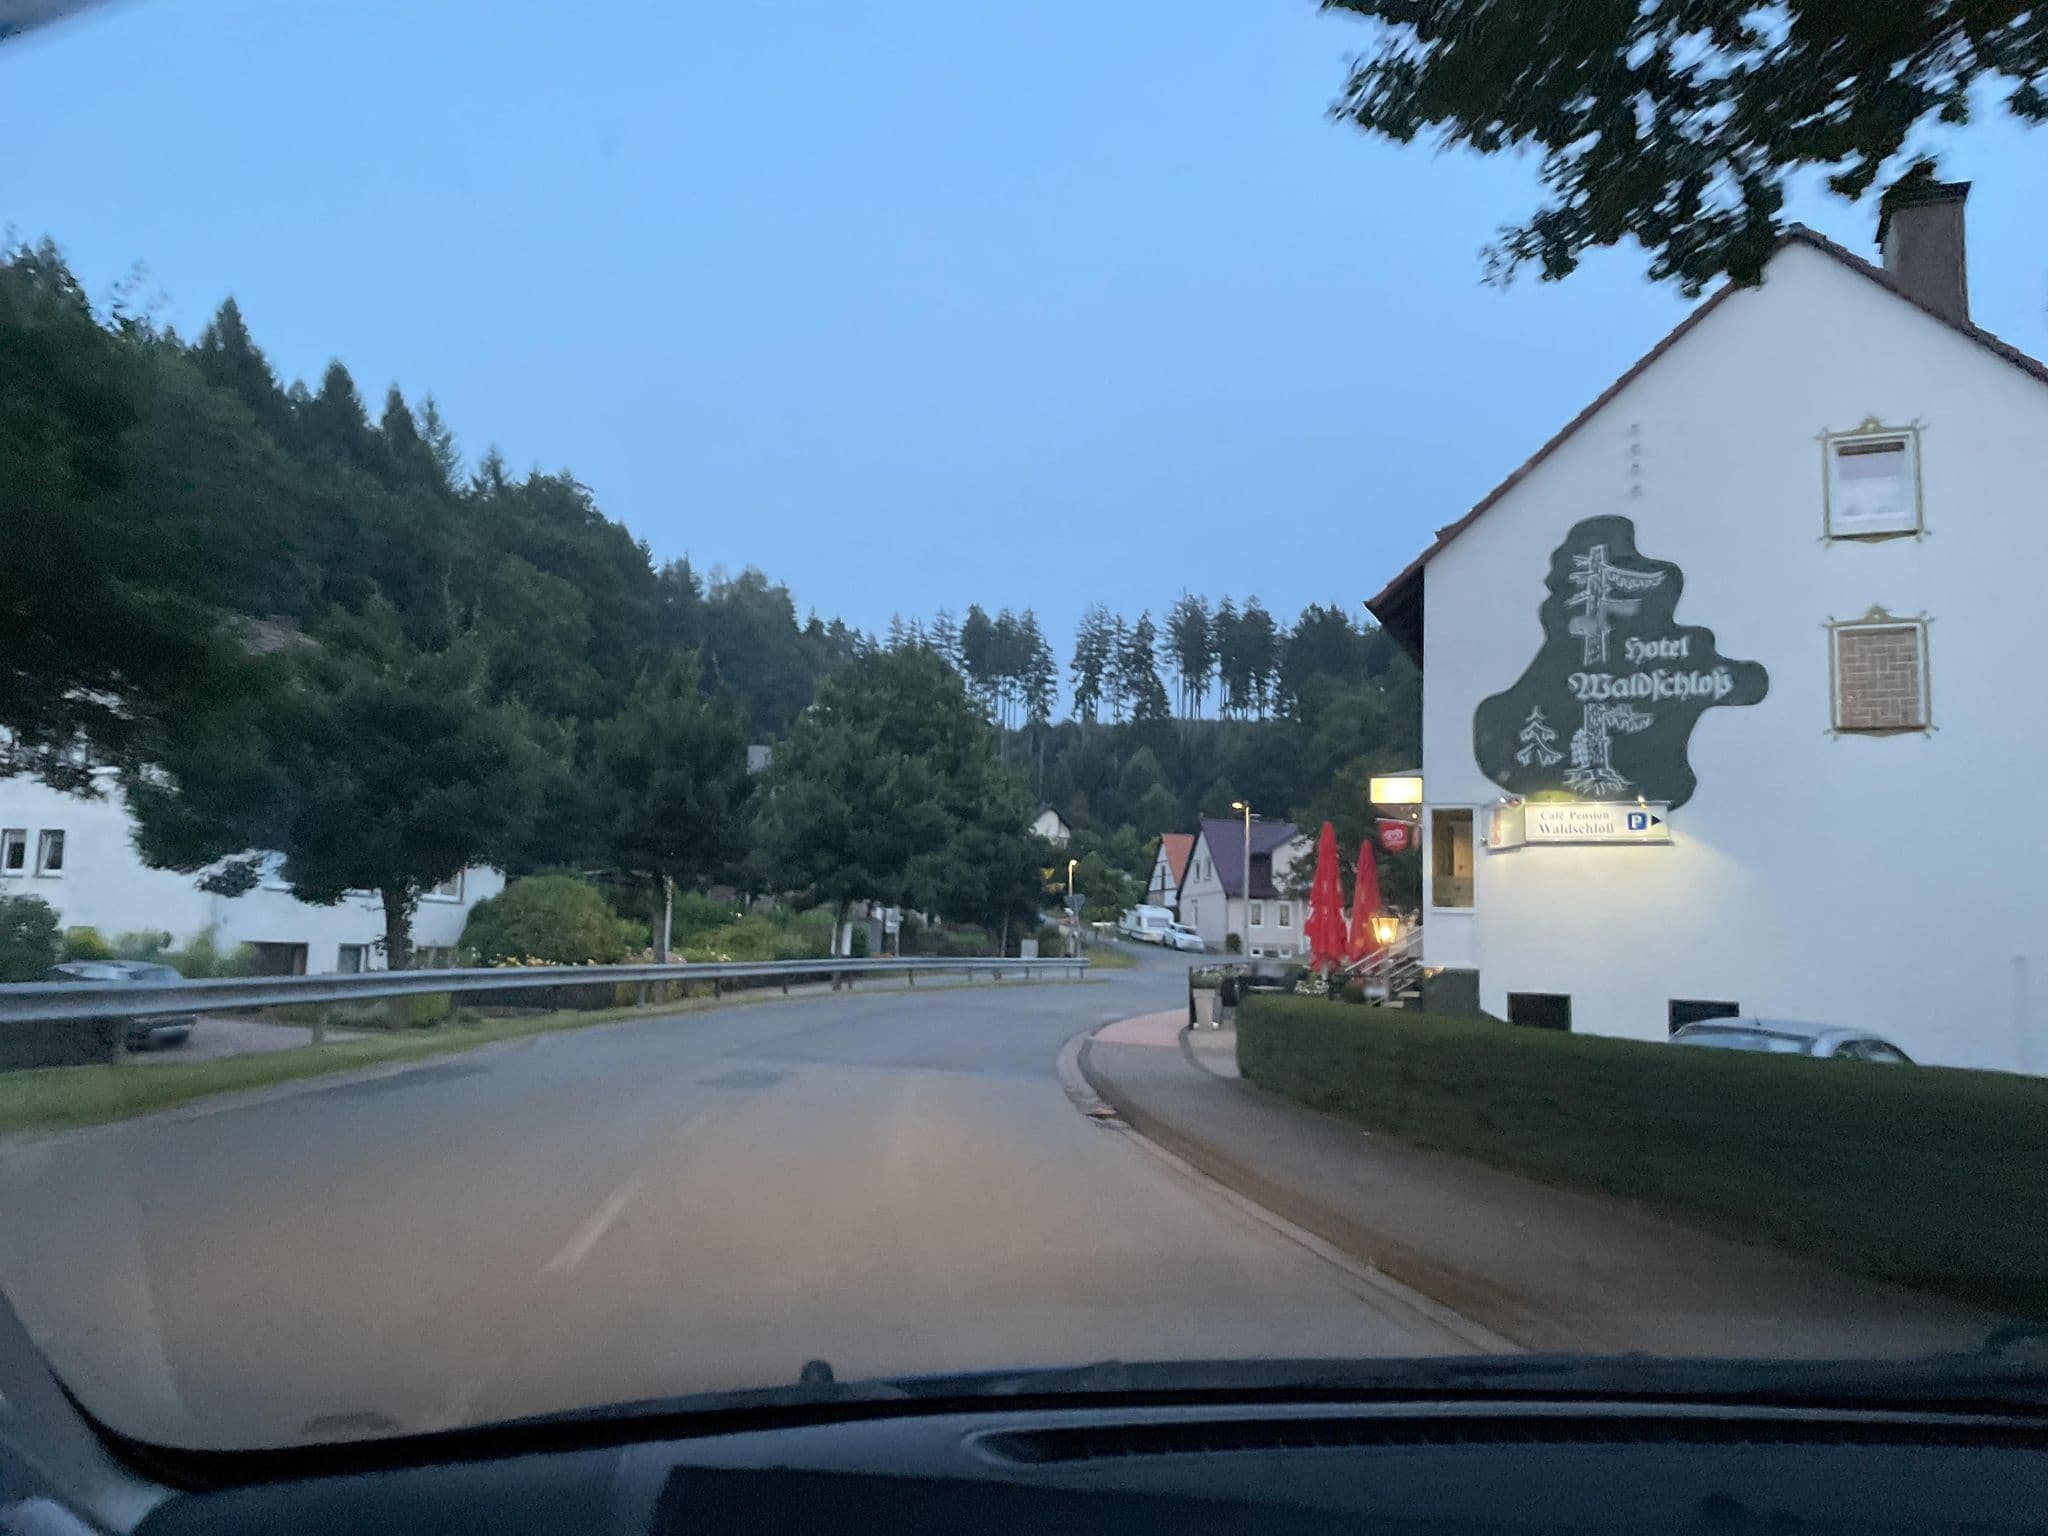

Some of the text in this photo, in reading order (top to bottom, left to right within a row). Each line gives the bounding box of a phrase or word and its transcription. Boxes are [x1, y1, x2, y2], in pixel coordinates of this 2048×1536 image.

[1625, 637, 1690, 663] Hotel
[1570, 811, 1610, 821] Pension
[1539, 823, 1615, 835] Waldschloß
